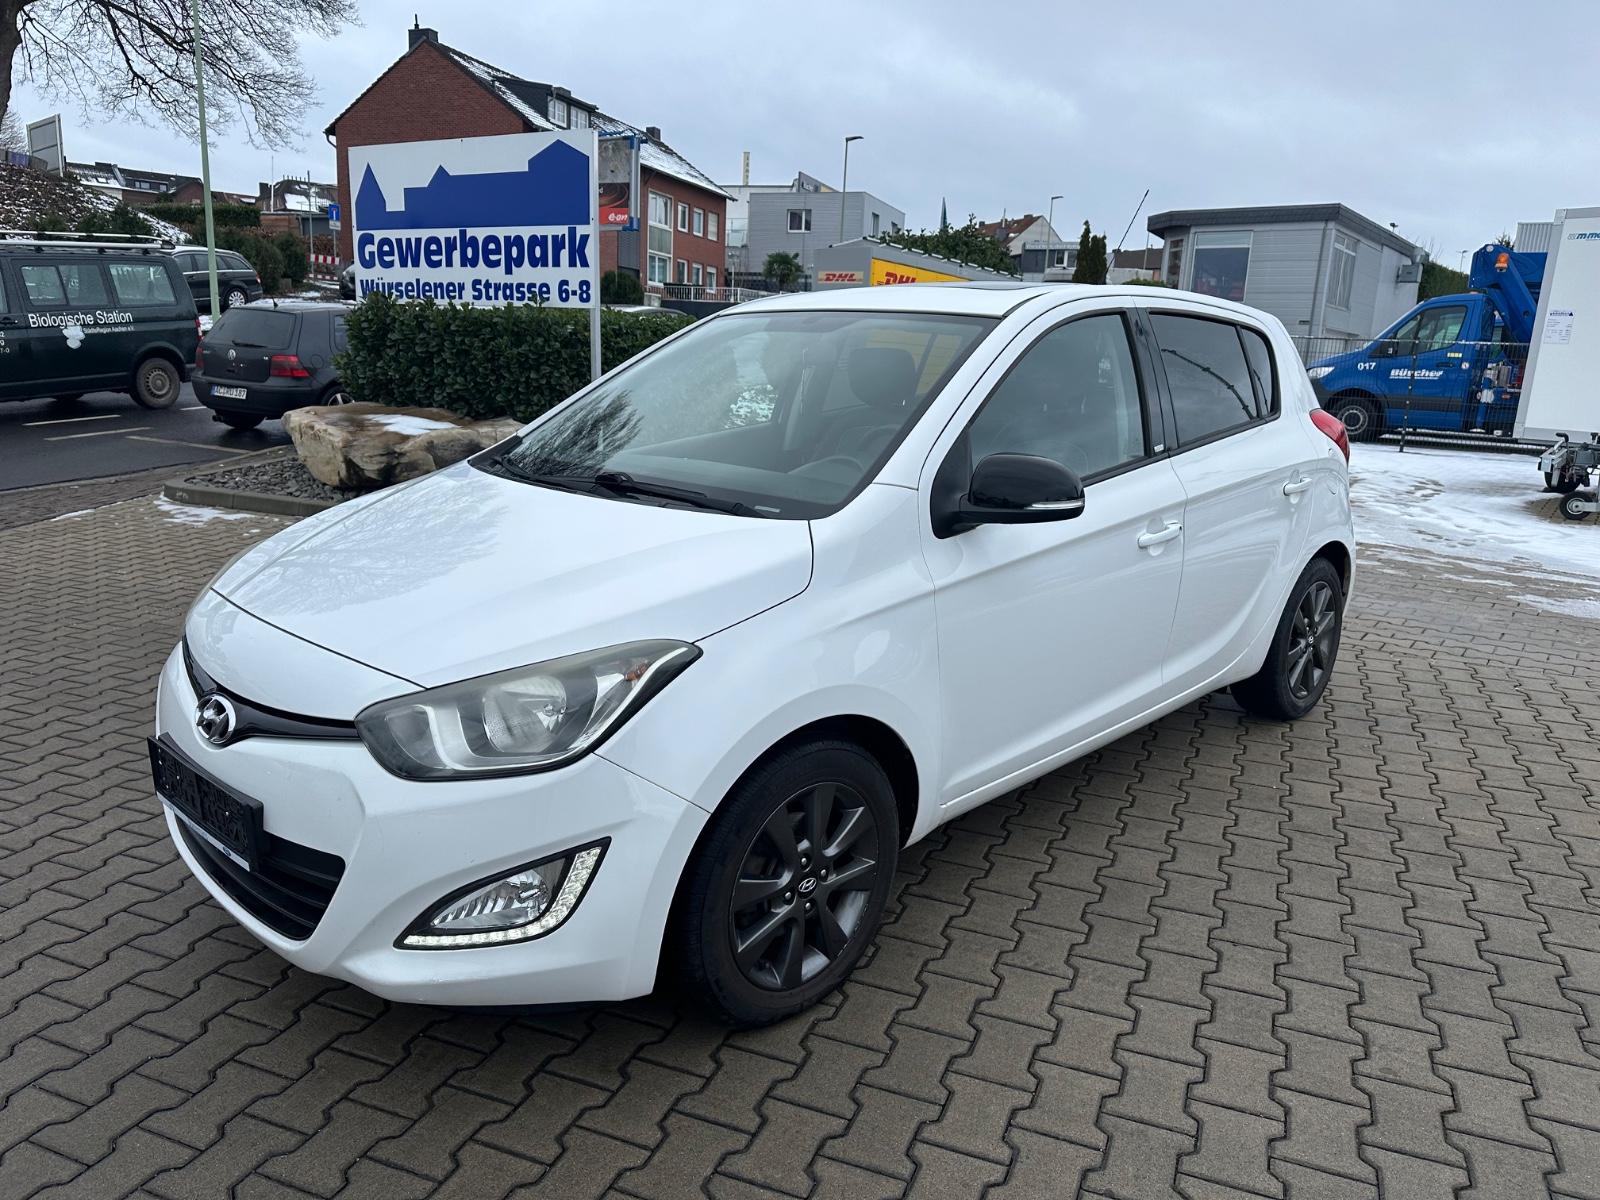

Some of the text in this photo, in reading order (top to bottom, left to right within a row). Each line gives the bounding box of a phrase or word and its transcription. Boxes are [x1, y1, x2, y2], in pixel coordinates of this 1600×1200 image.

[357, 226, 590, 275] Gewerbepark
[823, 273, 857, 282] DHL
[360, 277, 592, 304] Würselener Strasse 6-8
[28, 310, 133, 329] Biologische Station
[1357, 362, 1376, 371] 017
